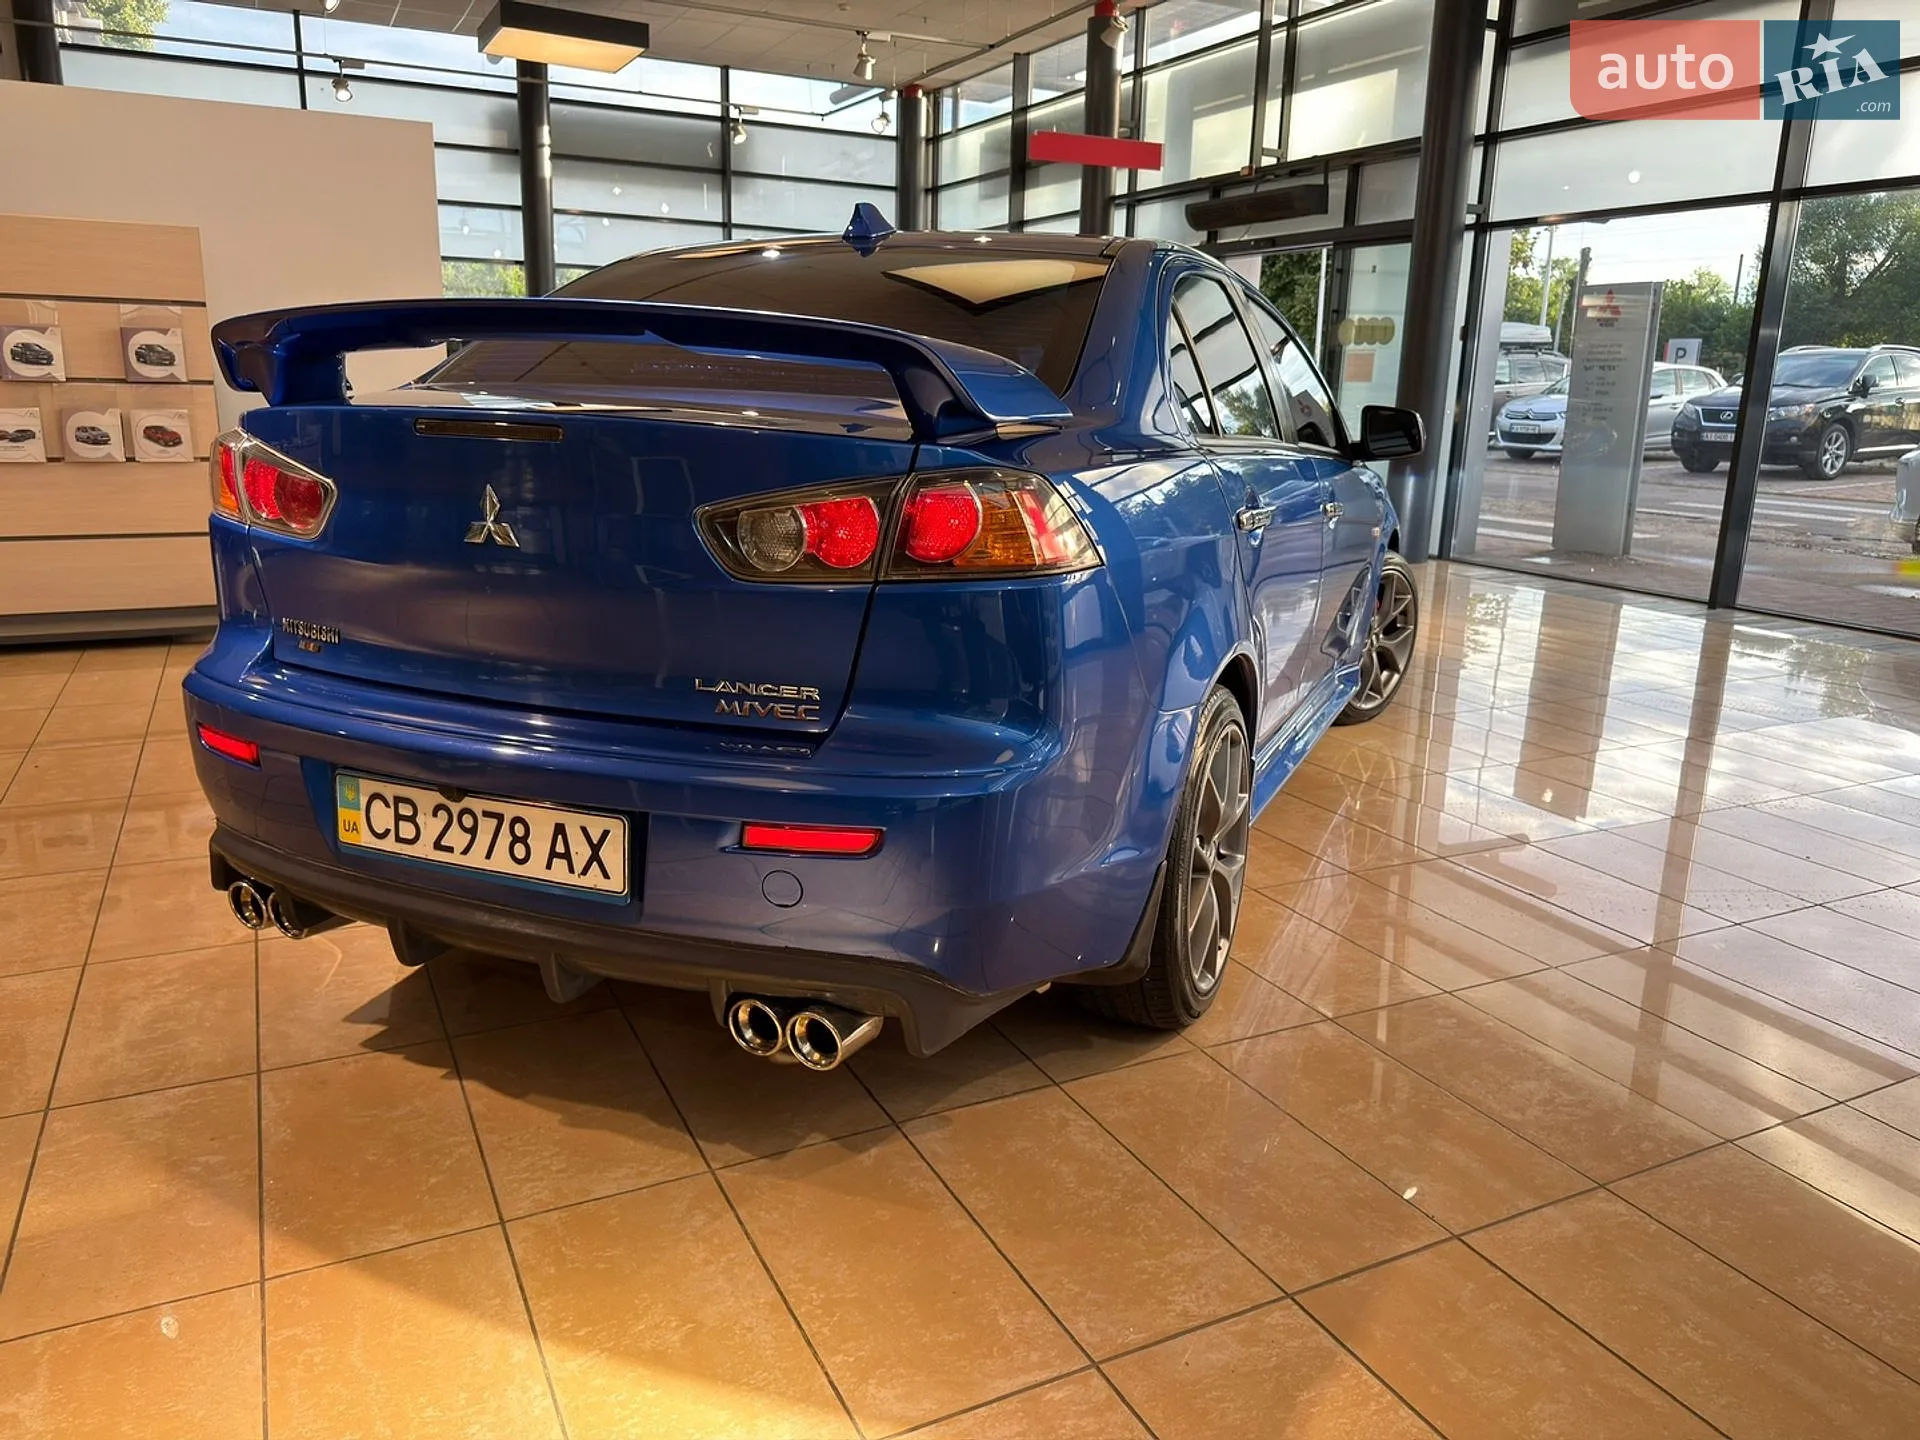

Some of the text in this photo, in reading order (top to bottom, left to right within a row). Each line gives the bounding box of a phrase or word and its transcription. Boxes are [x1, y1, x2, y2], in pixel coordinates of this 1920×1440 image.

[282, 617, 340, 644] MITSUBISHI
[695, 678, 821, 700] LANCER
[715, 699, 820, 720] MIVEC
[342, 822, 360, 835] UA
[365, 792, 612, 880] CB 2978 AX
